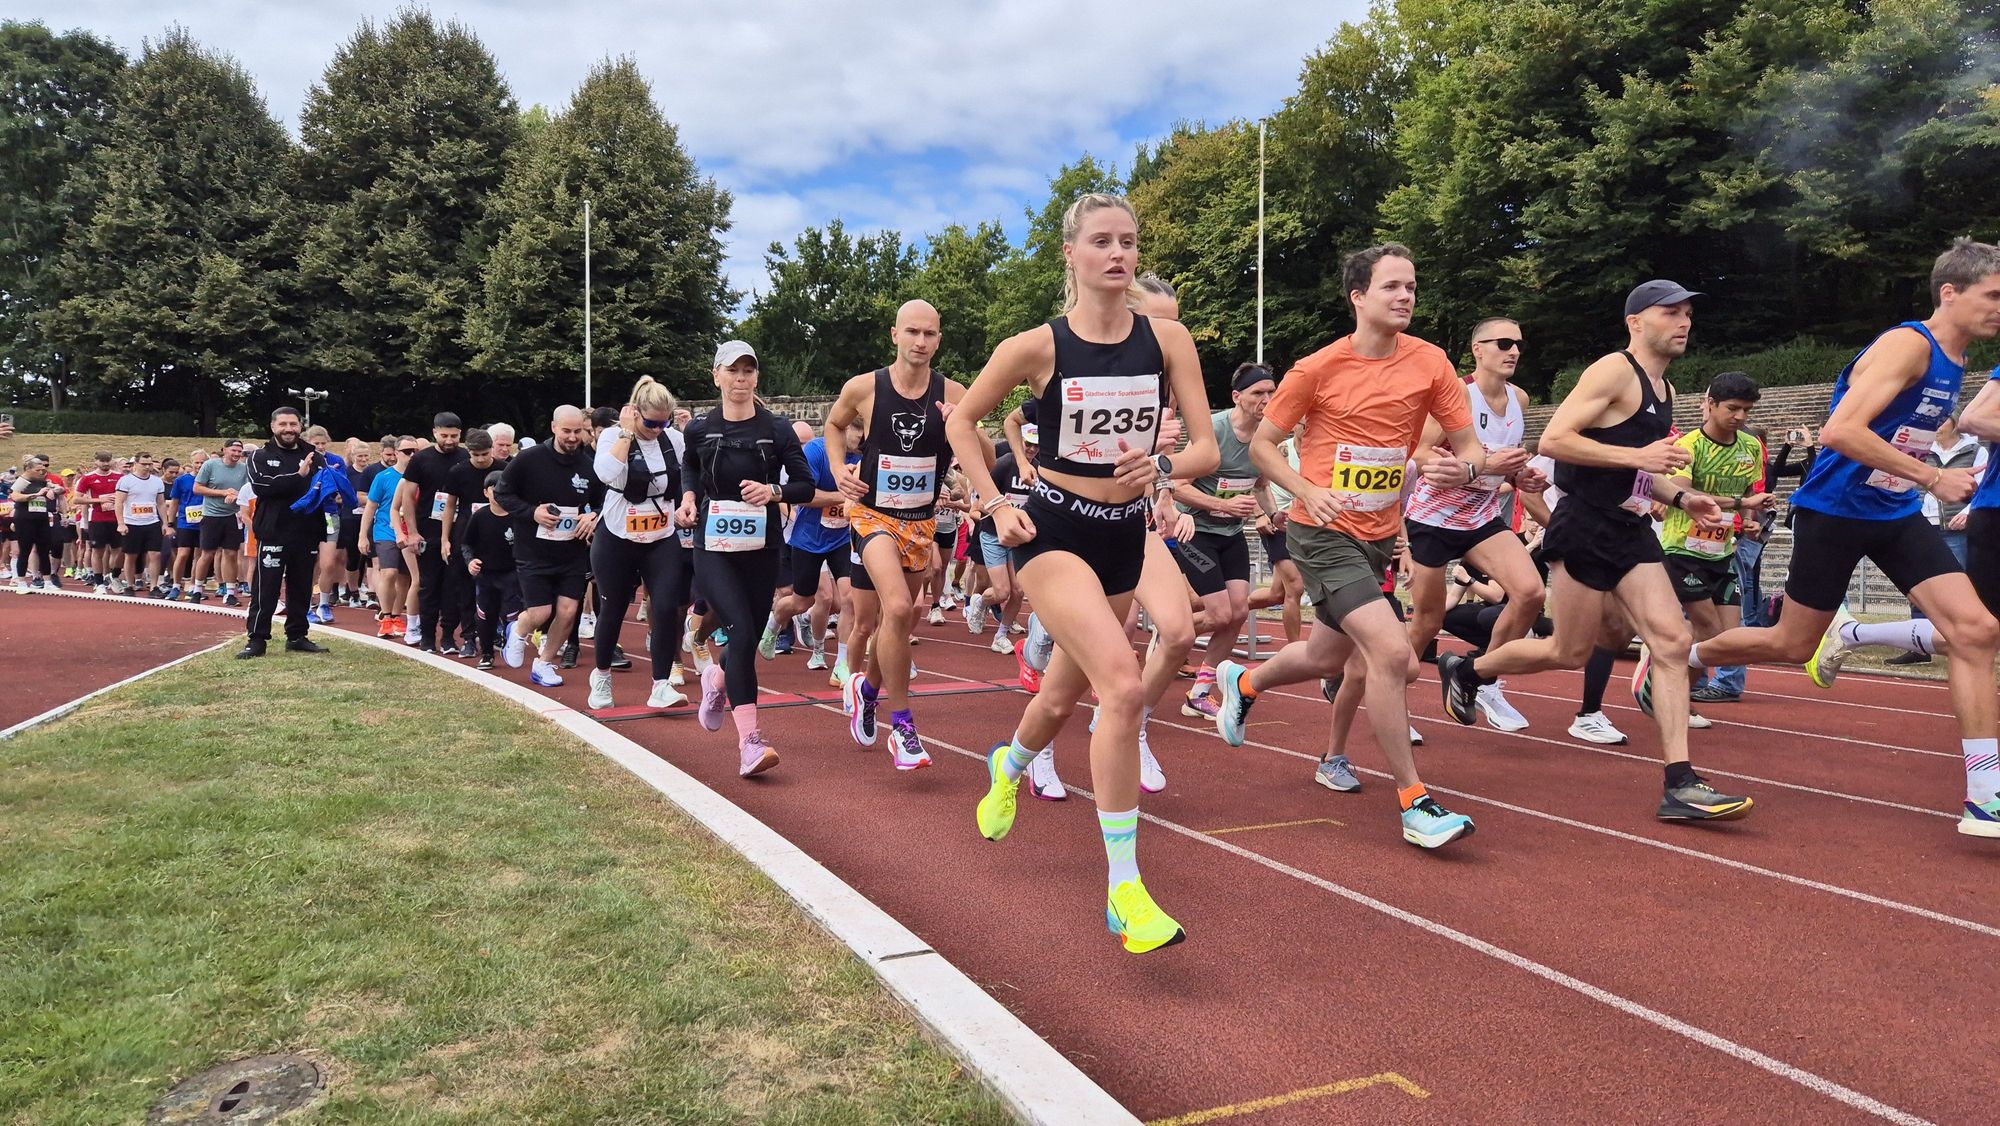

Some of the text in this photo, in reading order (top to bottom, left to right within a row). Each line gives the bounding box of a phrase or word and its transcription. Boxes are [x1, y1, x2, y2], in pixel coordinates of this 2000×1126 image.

[1069, 406, 1155, 435] 1235
[887, 474, 927, 491] 994
[1339, 467, 1402, 490] 1026
[1071, 499, 1122, 520] NIKE
[630, 514, 668, 530] 1179
[715, 518, 757, 535] 995
